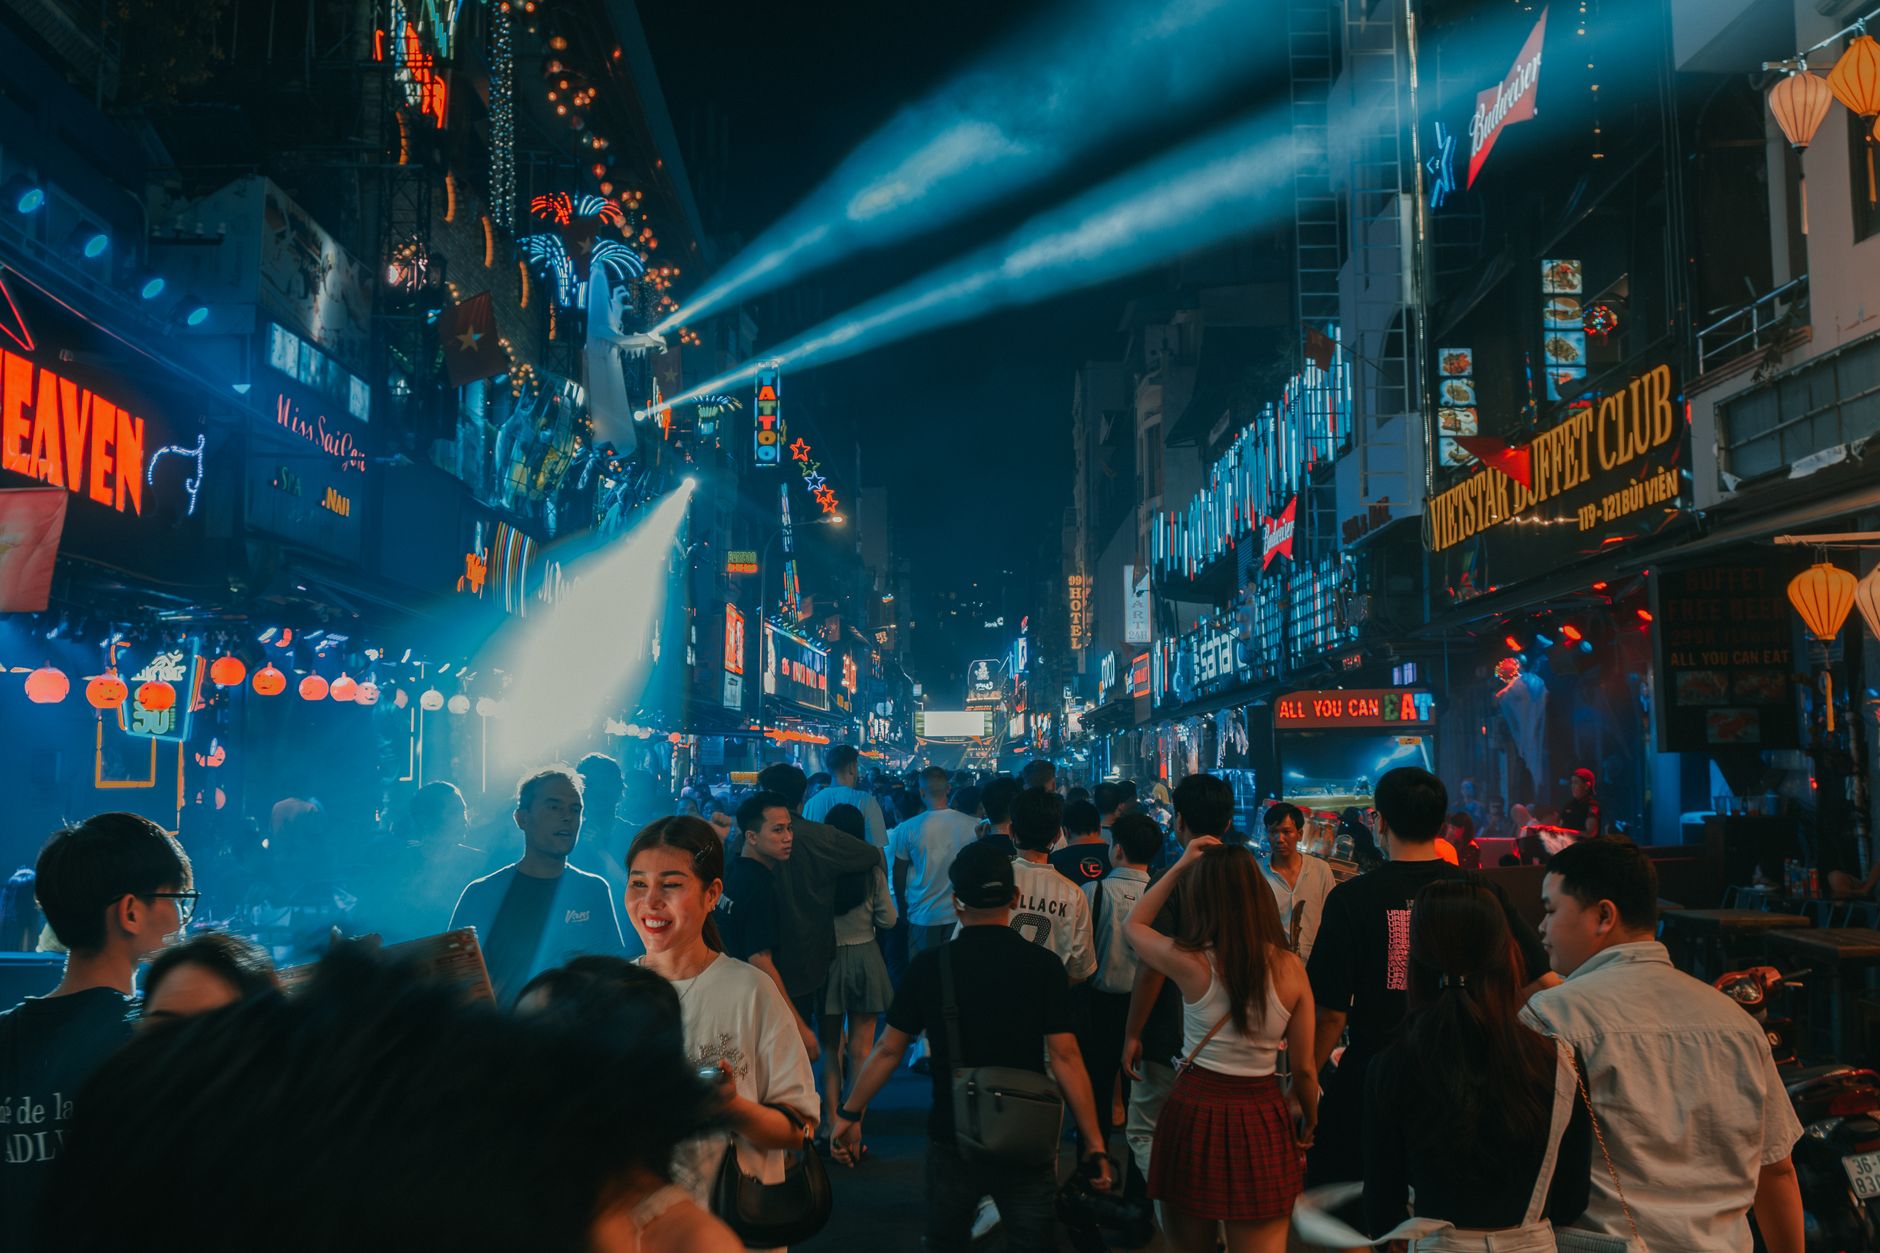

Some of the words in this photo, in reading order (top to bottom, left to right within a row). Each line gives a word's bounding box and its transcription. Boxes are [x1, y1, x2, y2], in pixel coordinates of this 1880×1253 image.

[1469, 52, 1542, 157] Budweiser
[0, 348, 144, 517] EAVEN
[758, 371, 776, 461] TATTOO
[1598, 364, 1673, 471] CLUB
[1264, 519, 1295, 556] Budweiser
[1069, 587, 1082, 650] HOTEL
[1670, 652, 1697, 667] ALL
[1700, 651, 1729, 666] YOU
[1732, 650, 1760, 665] CAN
[1763, 649, 1789, 664] EAT
[1279, 700, 1306, 719] ALL
[1312, 699, 1343, 718] YOU
[1347, 697, 1379, 717] CAN
[1383, 693, 1433, 721] EAT
[1020, 895, 1067, 917] LLACK
[16, 1096, 46, 1125] de
